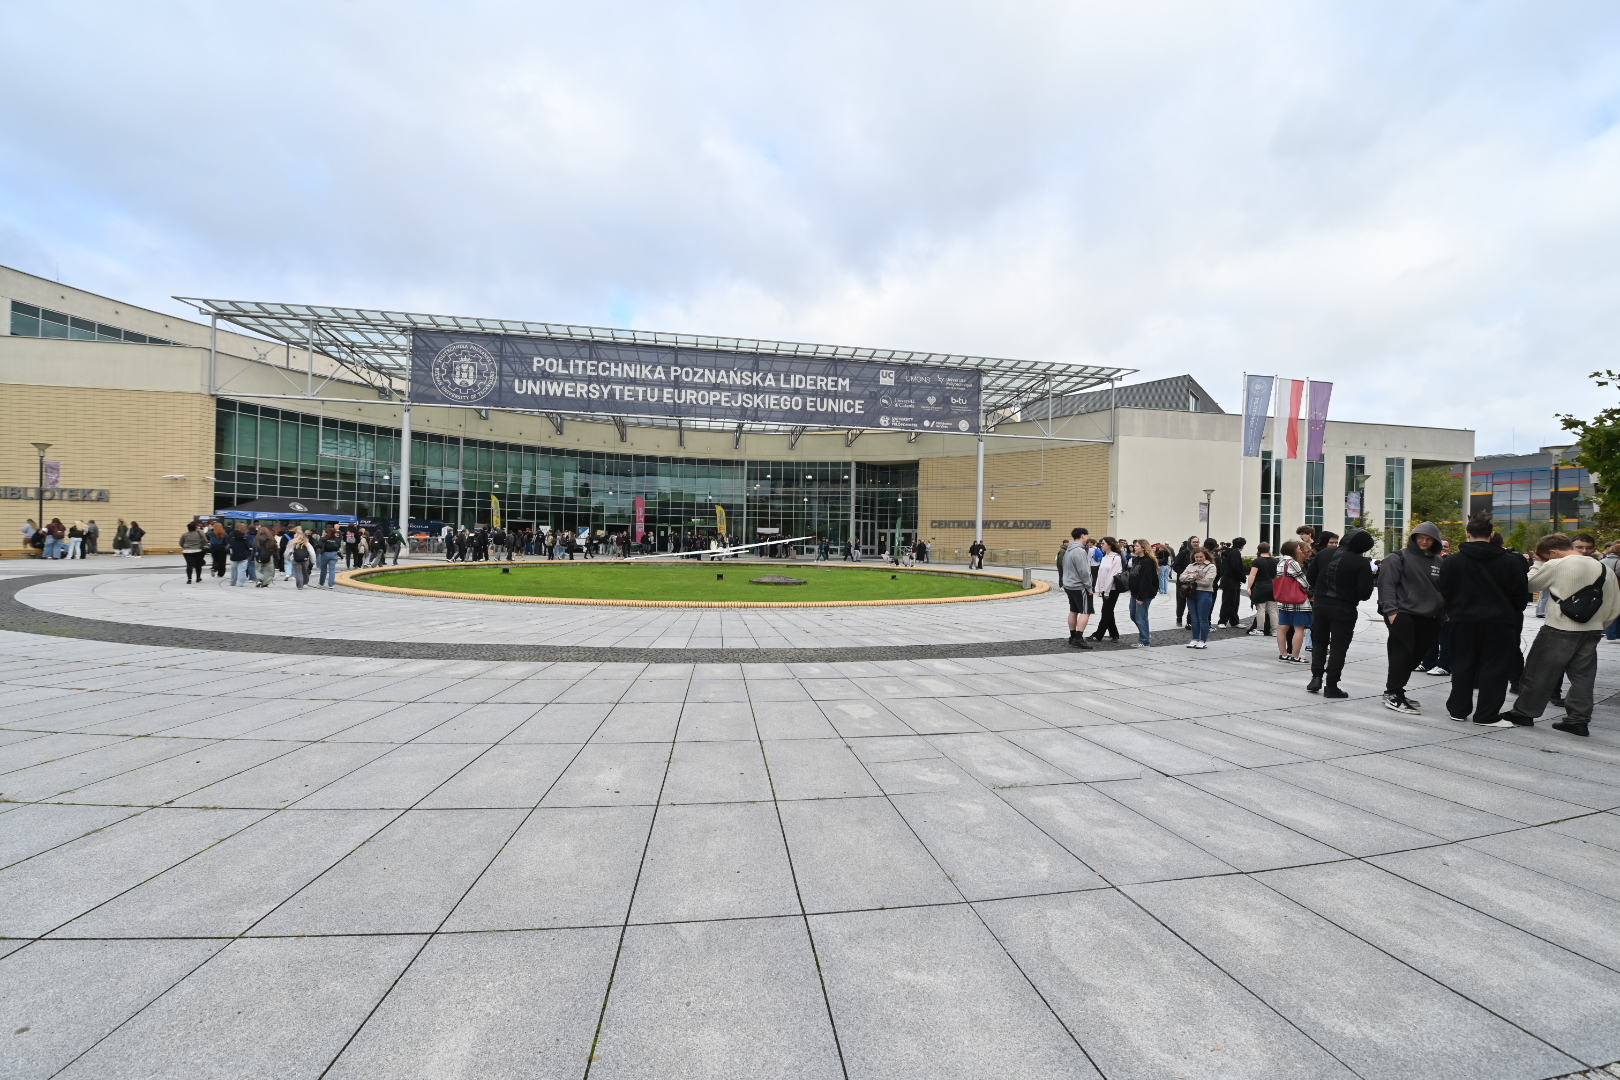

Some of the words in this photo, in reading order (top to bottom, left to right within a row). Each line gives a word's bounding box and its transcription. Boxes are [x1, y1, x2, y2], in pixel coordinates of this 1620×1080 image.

[533, 356, 665, 380] POLITECHNIKA
[670, 366, 776, 388] POZNAŃSKA
[780, 373, 850, 392] LIDEREM
[881, 370, 894, 379] UC
[905, 375, 931, 384] UMONS
[514, 378, 658, 402] UNIWERSYTETU
[662, 388, 802, 411] EUROPEJSKIEGO
[806, 397, 865, 414] EUNICE
[0, 486, 109, 502] IBLIOTEKA
[982, 520, 1051, 529] WYKŁADOWE
